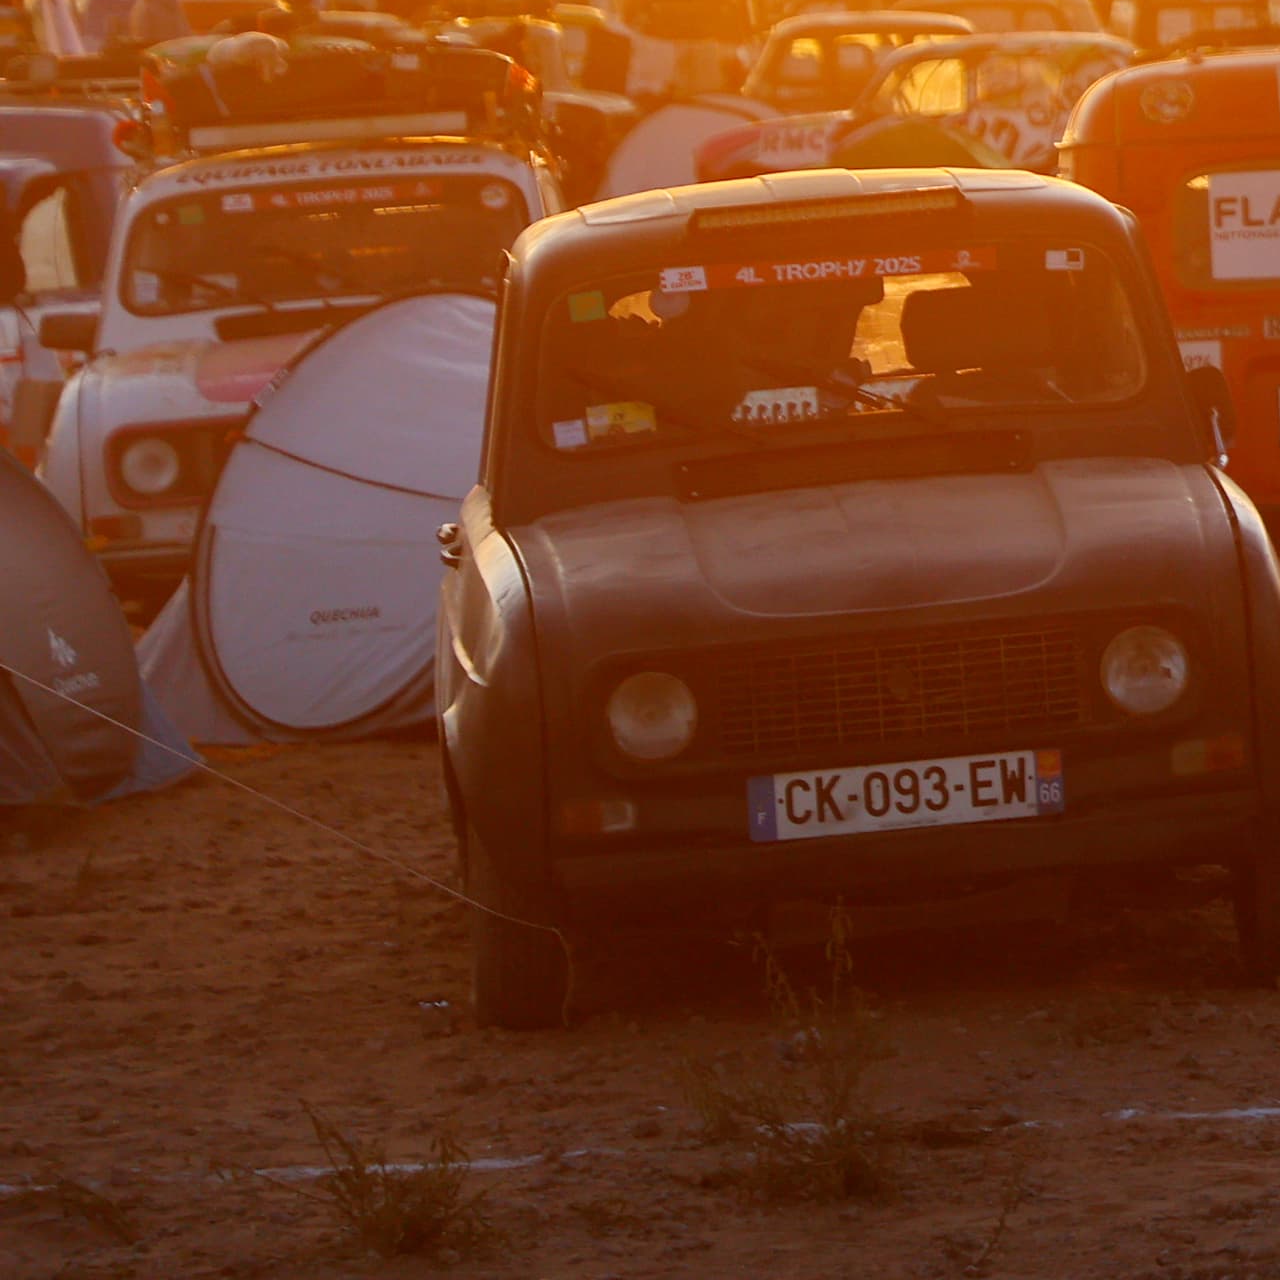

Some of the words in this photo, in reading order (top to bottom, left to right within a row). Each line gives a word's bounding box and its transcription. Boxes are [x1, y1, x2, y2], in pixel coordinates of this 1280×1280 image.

[760, 127, 826, 153] RMC
[735, 266, 764, 284] 4L
[773, 258, 866, 281] TROPHY
[873, 256, 921, 276] 2025
[309, 606, 382, 625] QUECHUA
[784, 757, 1027, 824] CK-093-EW
[1039, 781, 1062, 803] 66
[756, 810, 767, 826] F
